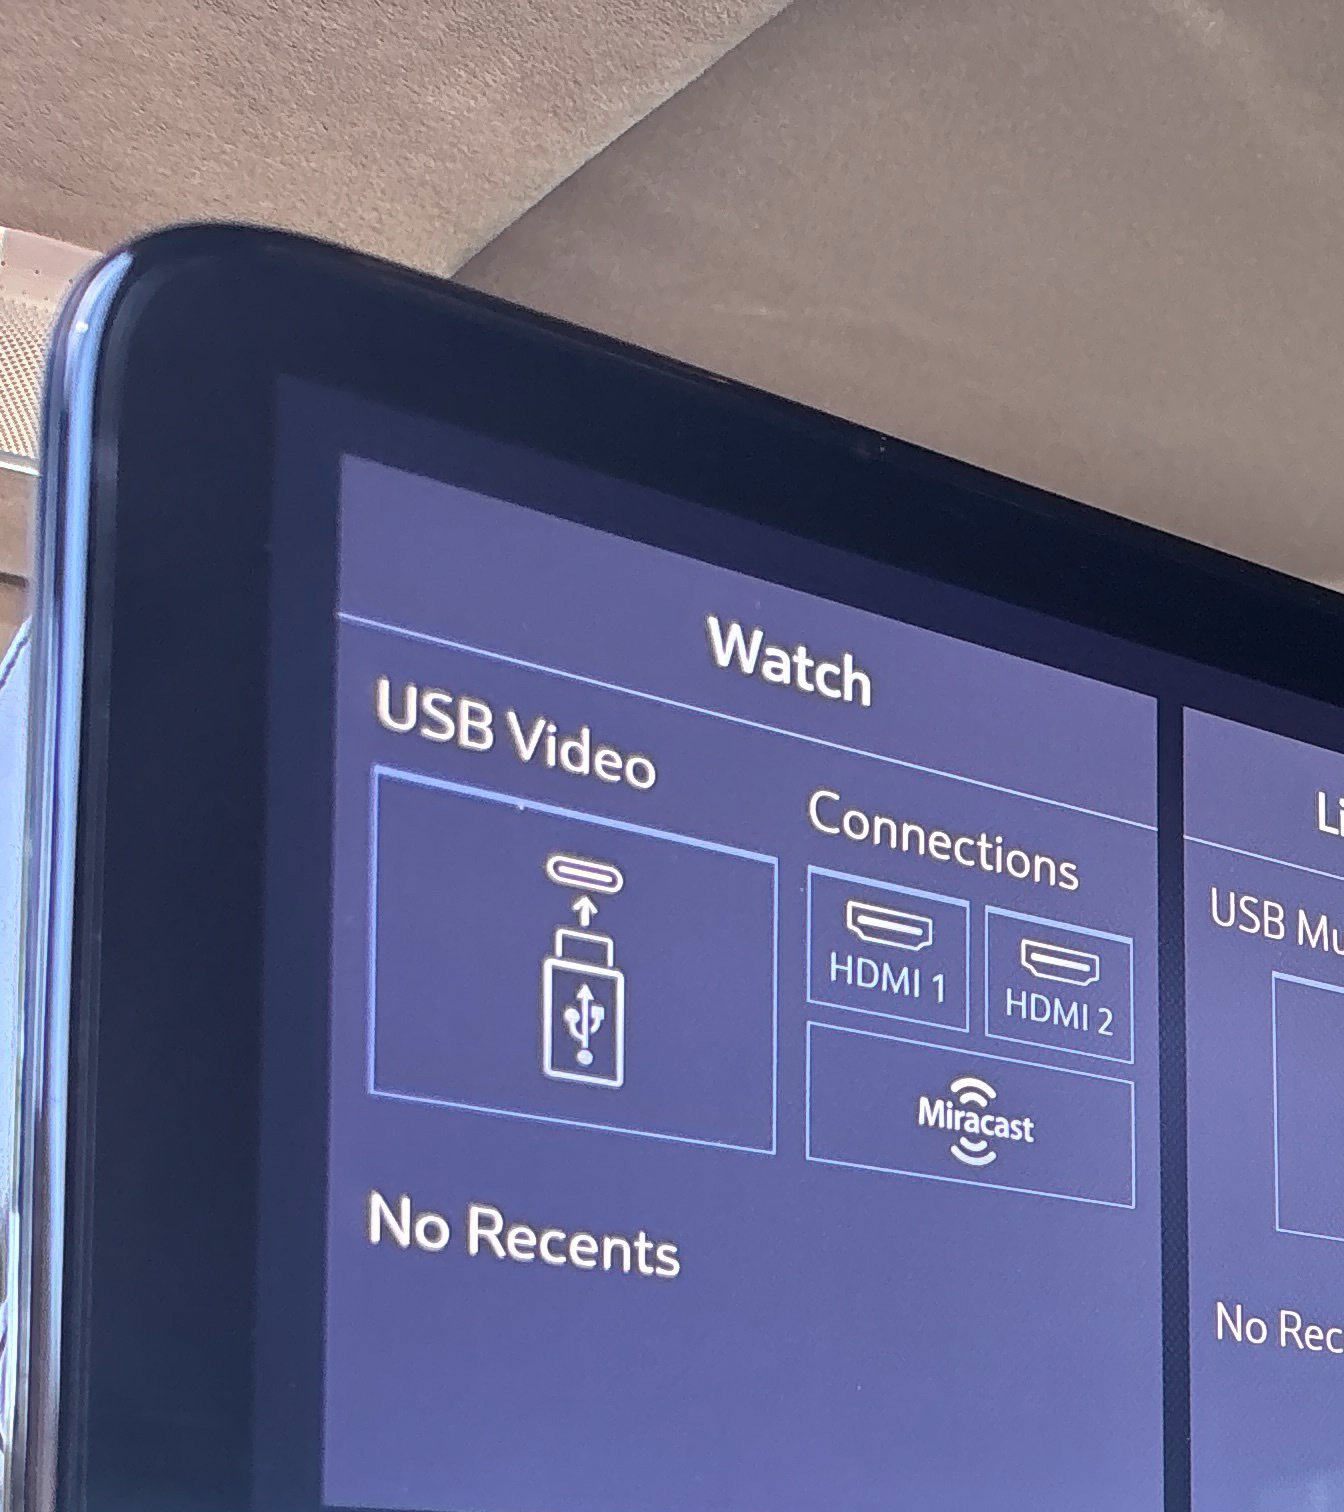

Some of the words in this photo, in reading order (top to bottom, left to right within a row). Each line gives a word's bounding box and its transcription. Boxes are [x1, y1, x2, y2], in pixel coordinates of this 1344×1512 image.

[706, 615, 871, 707] Watch
[378, 678, 494, 751] USB
[506, 710, 656, 789] Video
[808, 791, 1080, 891] Connections
[1211, 887, 1285, 940] USB
[830, 951, 920, 998] HDMI
[931, 972, 945, 1003] 1
[1006, 987, 1089, 1031] HDMI
[1097, 1007, 1114, 1036] 2
[918, 1096, 1034, 1143] Miracast
[370, 1190, 450, 1251] No
[469, 1204, 681, 1277] Recents
[1216, 1301, 1268, 1344] No
